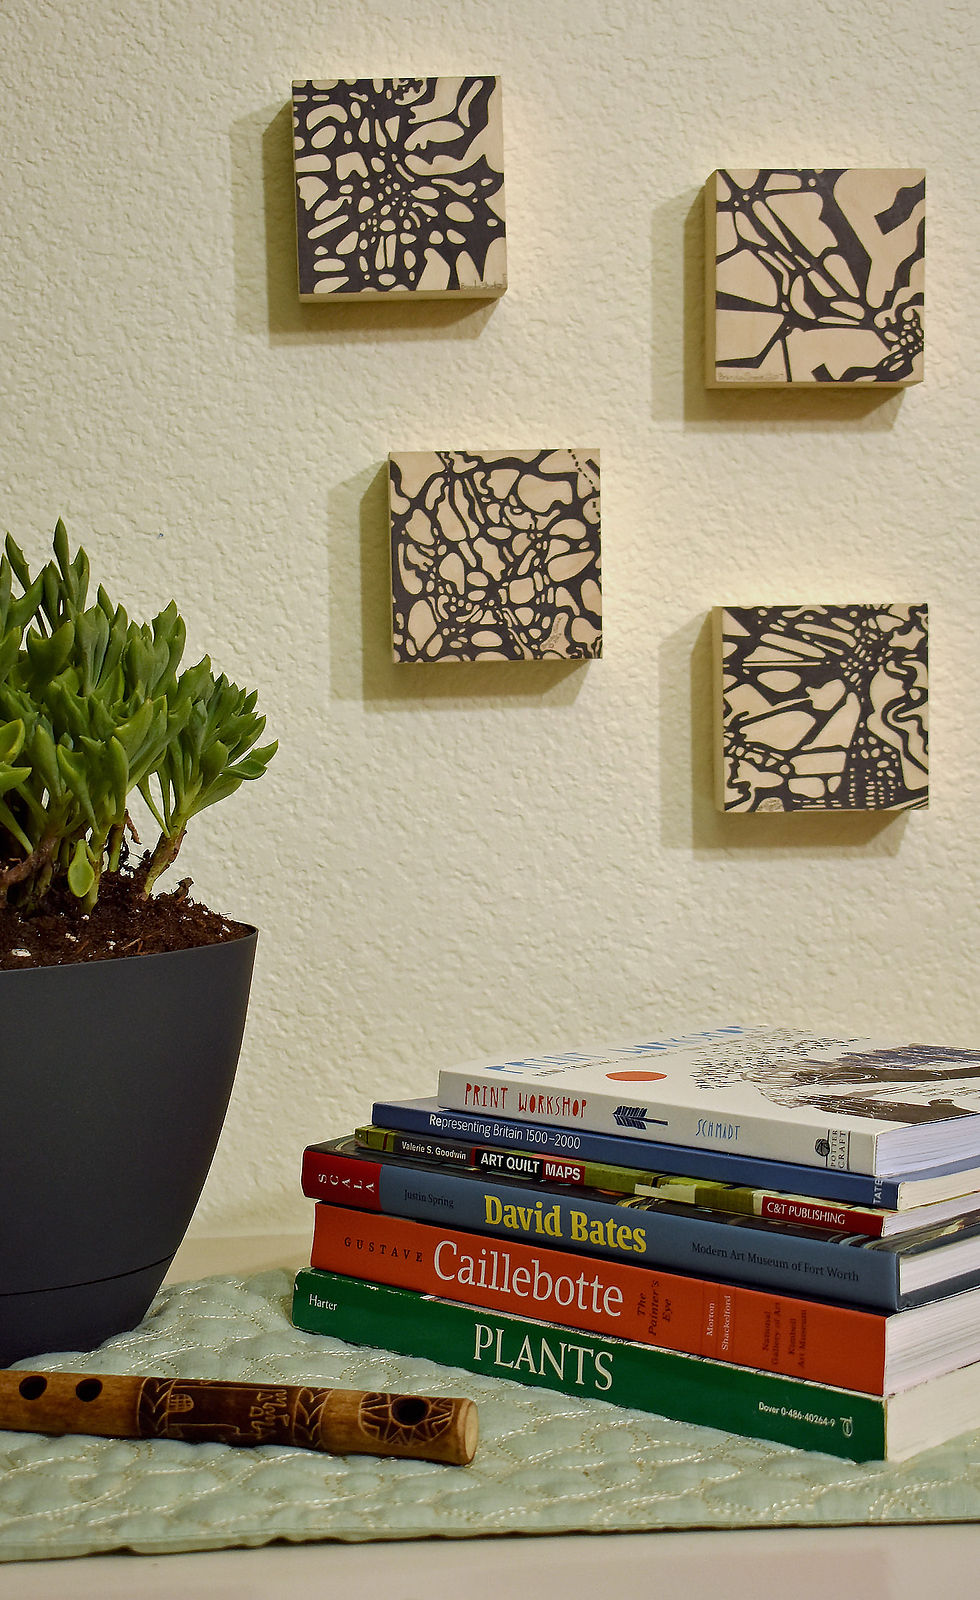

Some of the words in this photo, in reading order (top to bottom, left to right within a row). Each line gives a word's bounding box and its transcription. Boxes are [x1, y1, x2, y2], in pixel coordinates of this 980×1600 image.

[464, 1083, 508, 1109] PRINT
[518, 1092, 587, 1118] WORKSHOP
[429, 1113, 491, 1138] Representing
[493, 1123, 523, 1141] Britain
[401, 1141, 425, 1153] Valerie
[426, 1145, 434, 1154] S.
[435, 1147, 467, 1160] Goodwin
[830, 1130, 838, 1168] POTTER
[838, 1130, 847, 1169] CRAFT
[480, 1152, 504, 1168] ART
[506, 1156, 540, 1174] QUILT
[545, 1163, 581, 1181] MAPS
[404, 1189, 428, 1202] Justin
[428, 1194, 455, 1209] Spring
[872, 1178, 884, 1205] TATE
[484, 1194, 563, 1238] David
[569, 1210, 647, 1253] Bates
[766, 1202, 787, 1215] C&T
[788, 1205, 846, 1225] PUBLISHING
[691, 1241, 728, 1259] Modern
[730, 1250, 746, 1262] Art
[747, 1252, 789, 1270] Museum
[791, 1260, 802, 1272] of
[804, 1262, 825, 1276] Fort
[826, 1266, 860, 1282] Worth
[433, 1240, 624, 1318] Caillebotte
[308, 1293, 338, 1311] Harter
[636, 1292, 646, 1317] The
[662, 1298, 673, 1323] Eye
[705, 1302, 715, 1337] Morton
[721, 1294, 732, 1351] Shackelford
[473, 1323, 614, 1391] PLANTS
[758, 1401, 780, 1415] Dover
